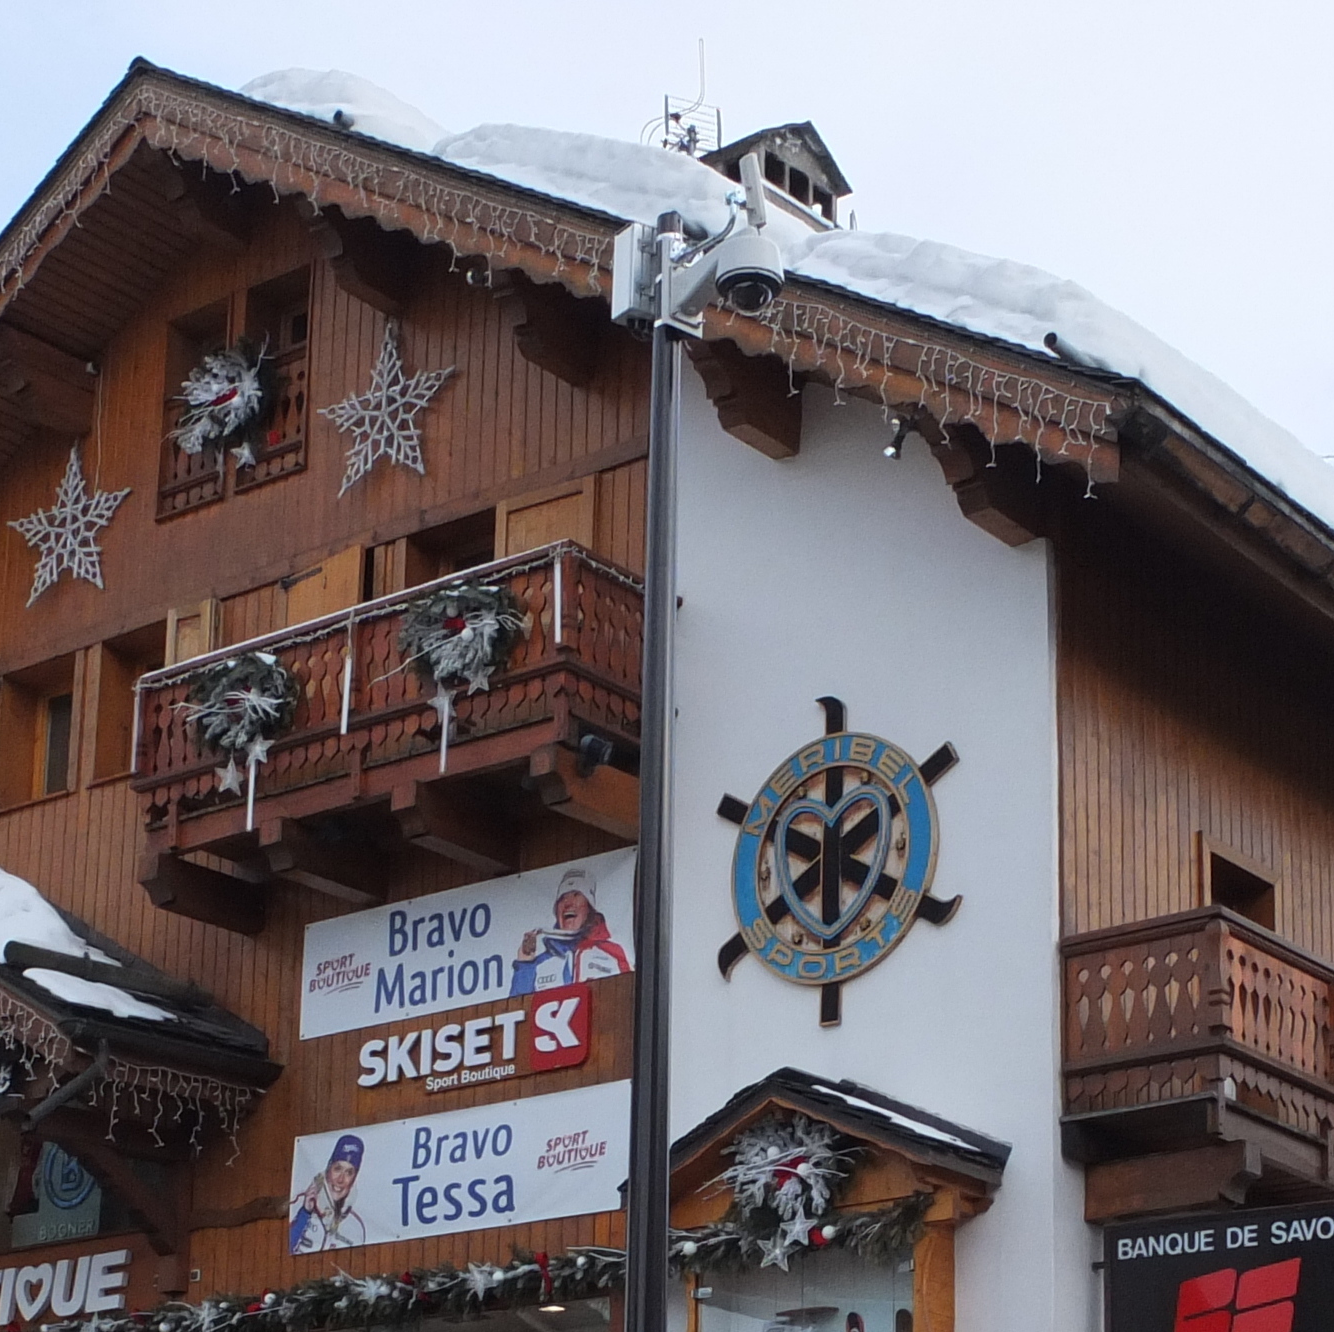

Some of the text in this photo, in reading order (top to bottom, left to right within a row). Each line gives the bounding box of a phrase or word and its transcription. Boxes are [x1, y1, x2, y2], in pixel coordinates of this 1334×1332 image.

[744, 736, 919, 836] MERIBEL
[388, 903, 491, 957] Bravo
[746, 888, 918, 979] SPORTS
[309, 962, 371, 993] BOUTIQUE
[316, 953, 355, 976] SPORT
[374, 951, 503, 1013] Marion
[357, 1010, 525, 1088] SKISET
[425, 1062, 516, 1092] Sport Boutique
[411, 1123, 513, 1170] Bravo
[537, 1140, 608, 1170] BOUTIQUE
[545, 1129, 589, 1153] SPORT
[392, 1174, 516, 1227] Tessa
[39, 1220, 94, 1240] BOGNER
[1117, 1229, 1215, 1261] BANQUE
[1226, 1225, 1259, 1249] DE
